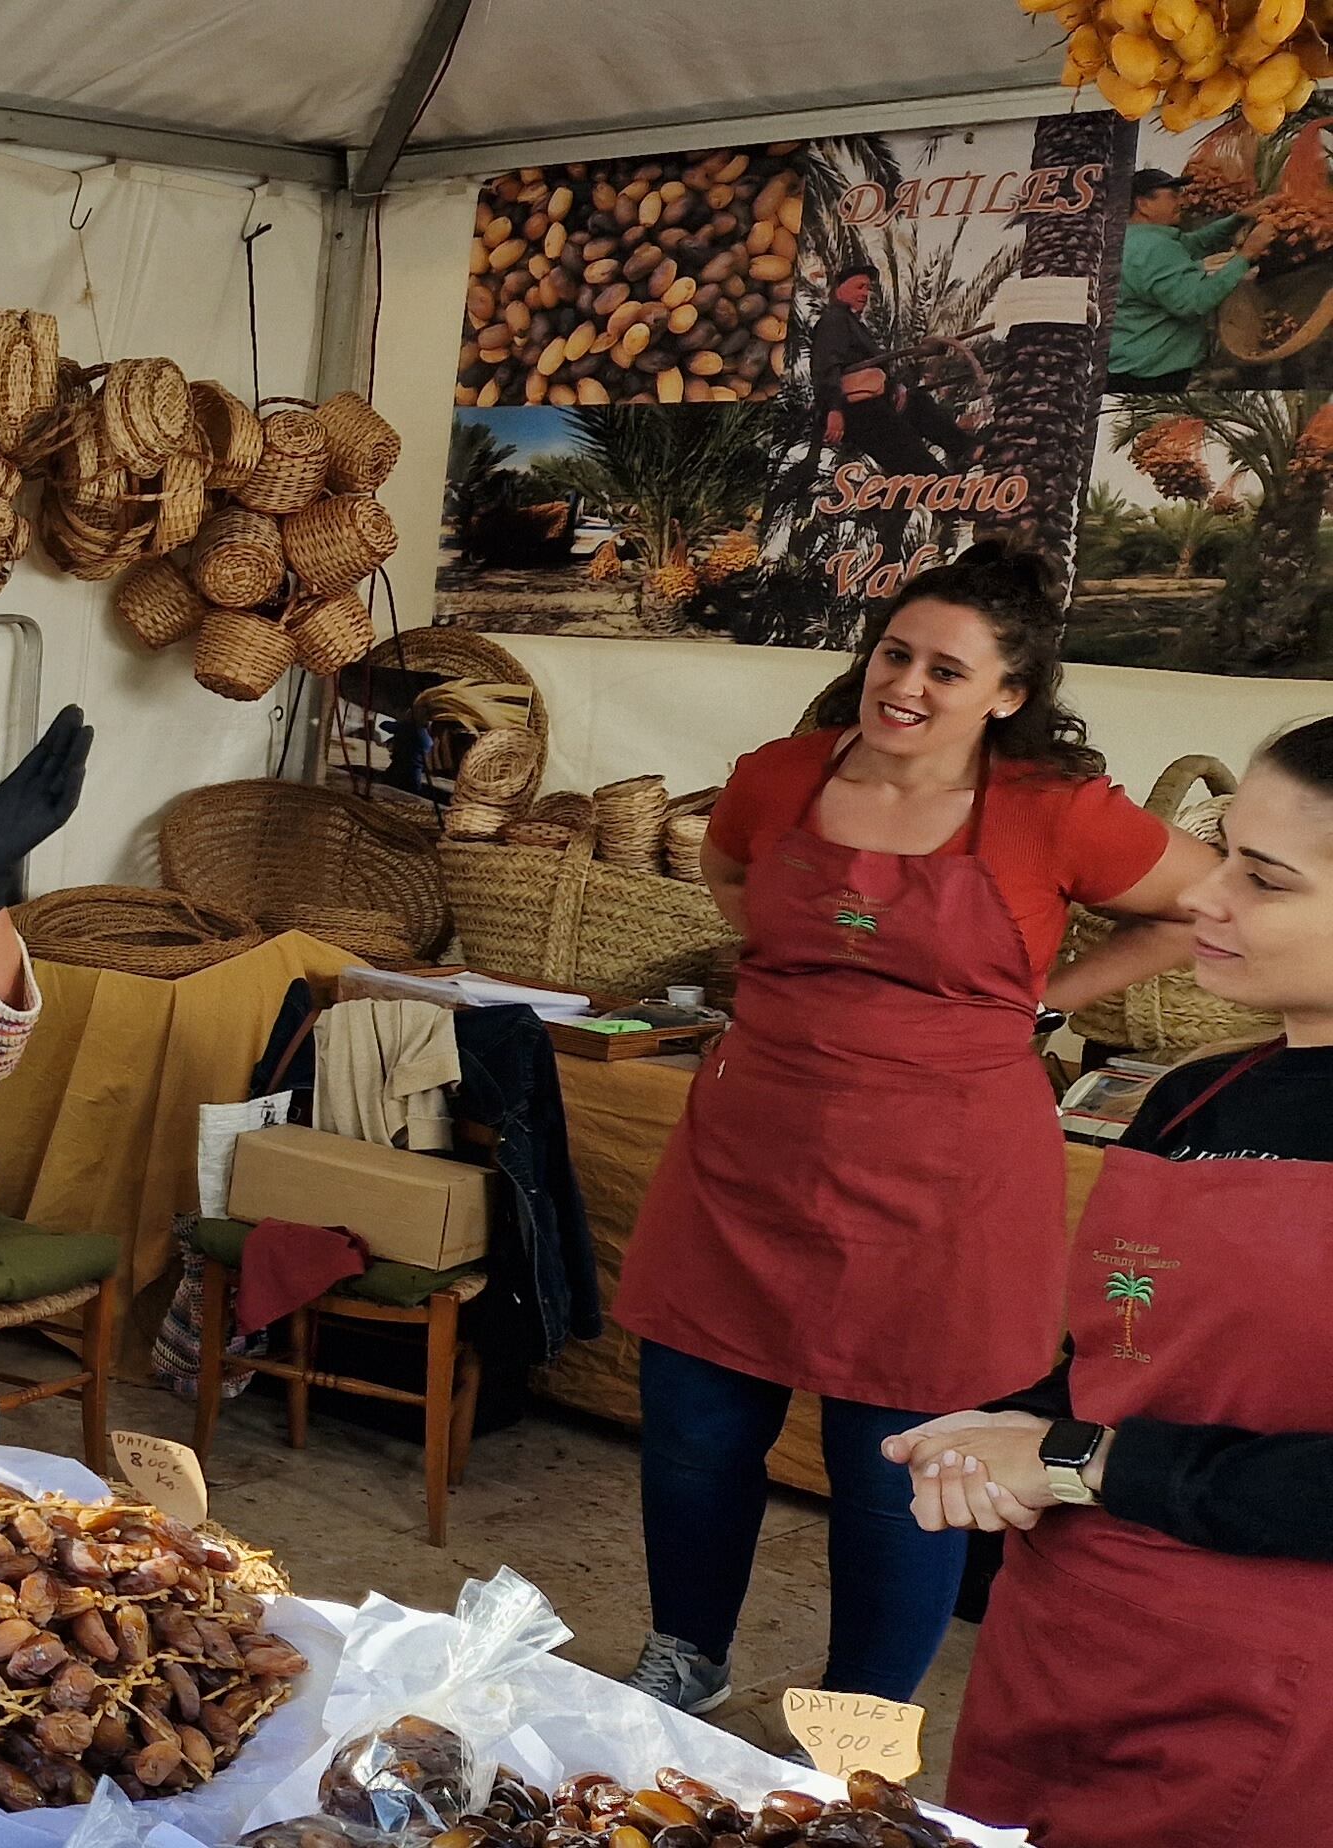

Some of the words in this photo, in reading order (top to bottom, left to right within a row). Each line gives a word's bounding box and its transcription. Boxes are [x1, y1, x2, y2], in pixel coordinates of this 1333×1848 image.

[837, 163, 1103, 228] DATILES
[817, 461, 1029, 514] Serrano
[825, 543, 940, 598] Val
[1112, 1343, 1152, 1364] Elche
[788, 1691, 910, 1723] DATILES
